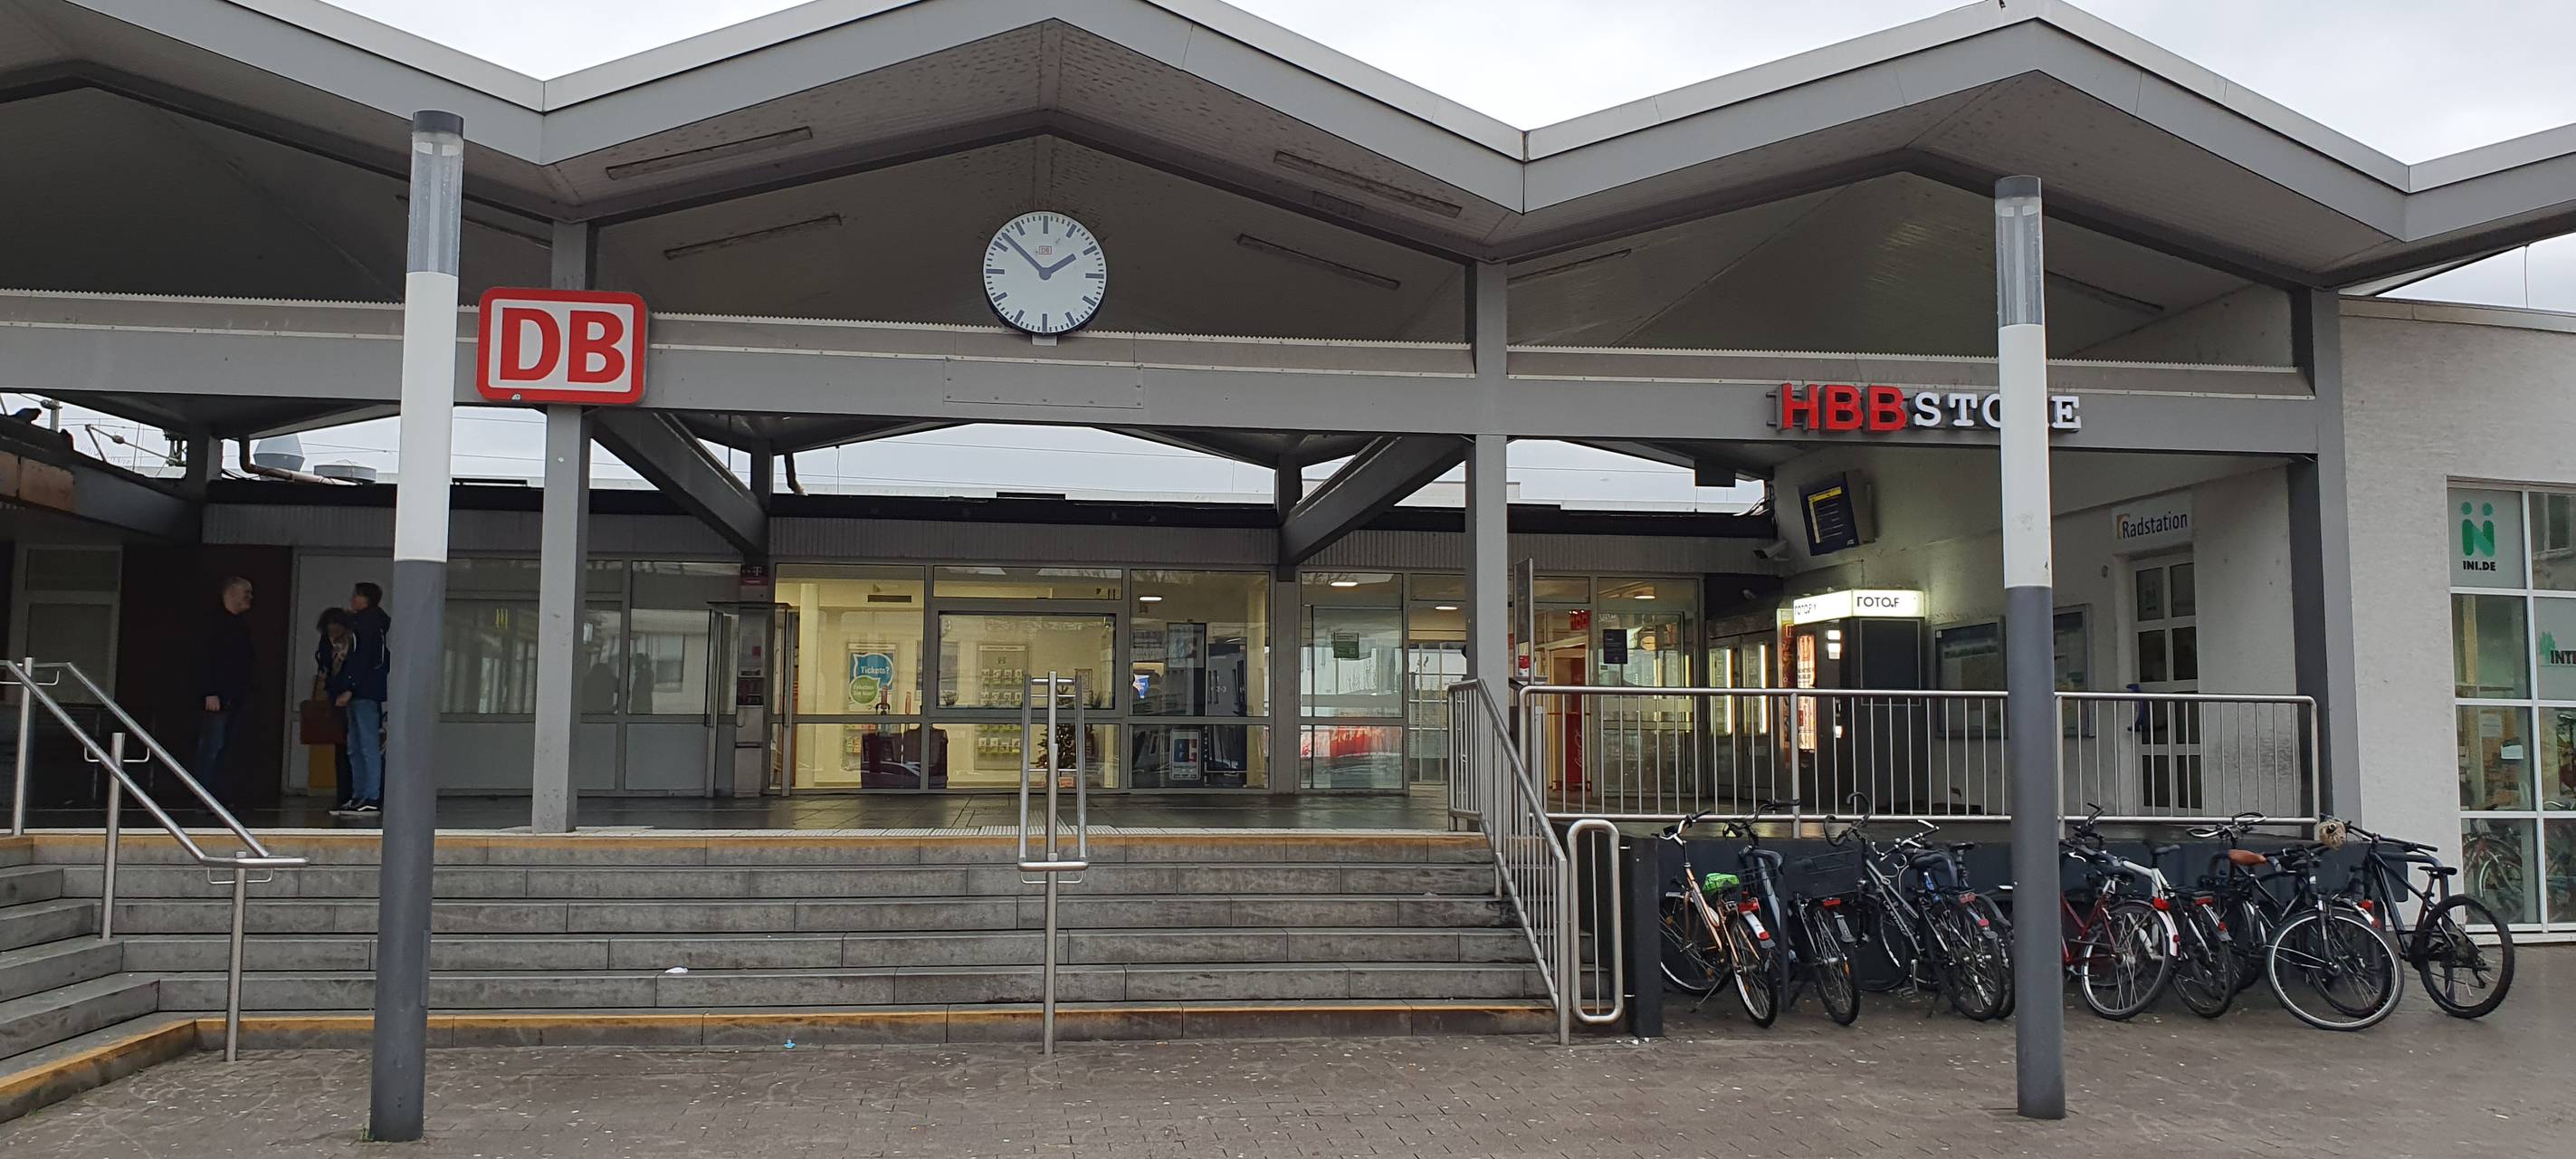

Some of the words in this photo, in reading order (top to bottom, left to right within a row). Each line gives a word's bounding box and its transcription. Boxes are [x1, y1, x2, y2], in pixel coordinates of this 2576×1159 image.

[500, 307, 626, 384] DB
[1913, 392, 2082, 428] STOE
[2122, 511, 2188, 539] Radstation
[2462, 560, 2496, 571] INI.DE
[861, 666, 890, 675] Tickets?
